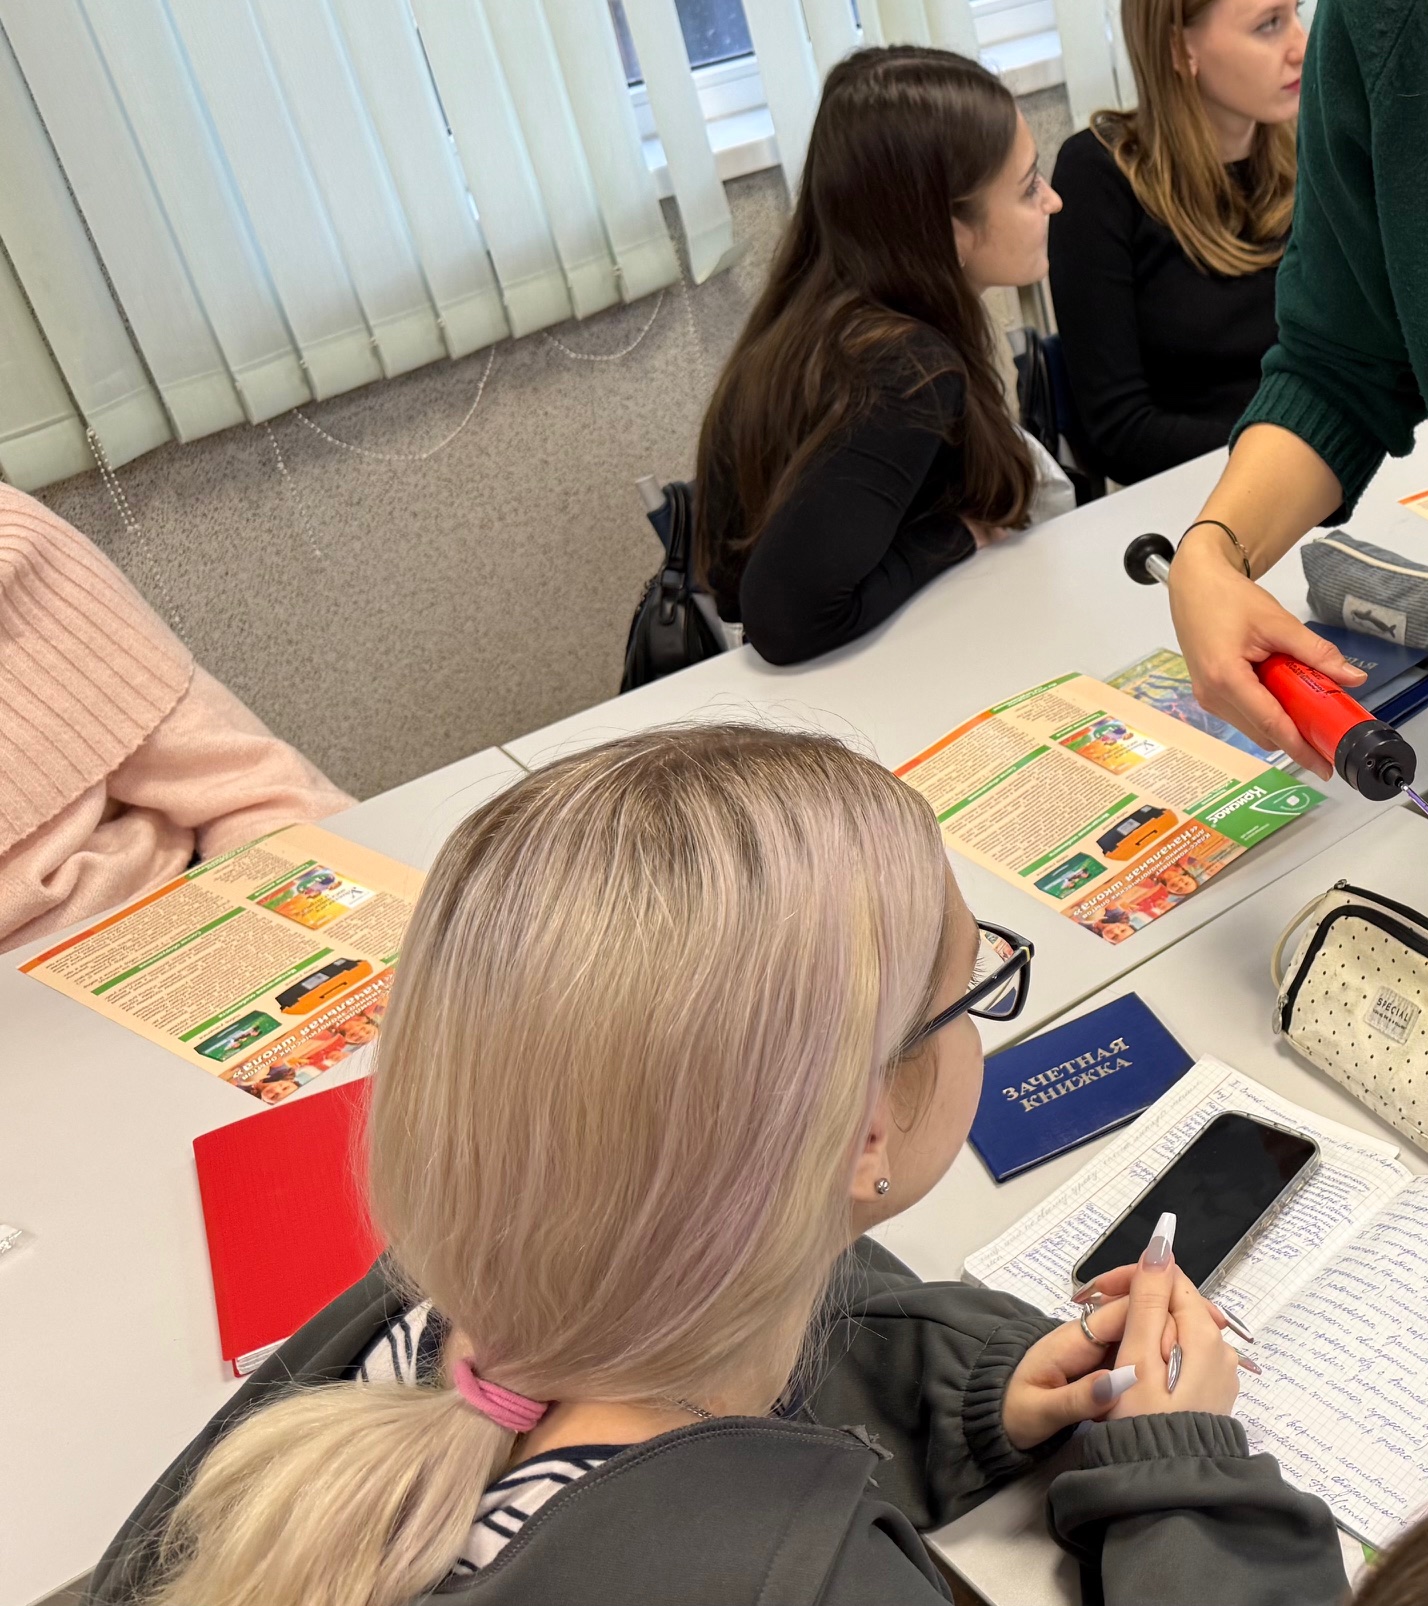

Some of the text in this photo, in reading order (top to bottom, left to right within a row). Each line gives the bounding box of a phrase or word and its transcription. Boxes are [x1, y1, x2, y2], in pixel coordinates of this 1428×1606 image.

[1073, 825, 1199, 917] «Начальная школа»
[1377, 998, 1409, 1022] SPECIAL
[1002, 1037, 1130, 1101] ЗАЧЕТНАЯ
[1019, 1058, 1133, 1113] КНИЖКА
